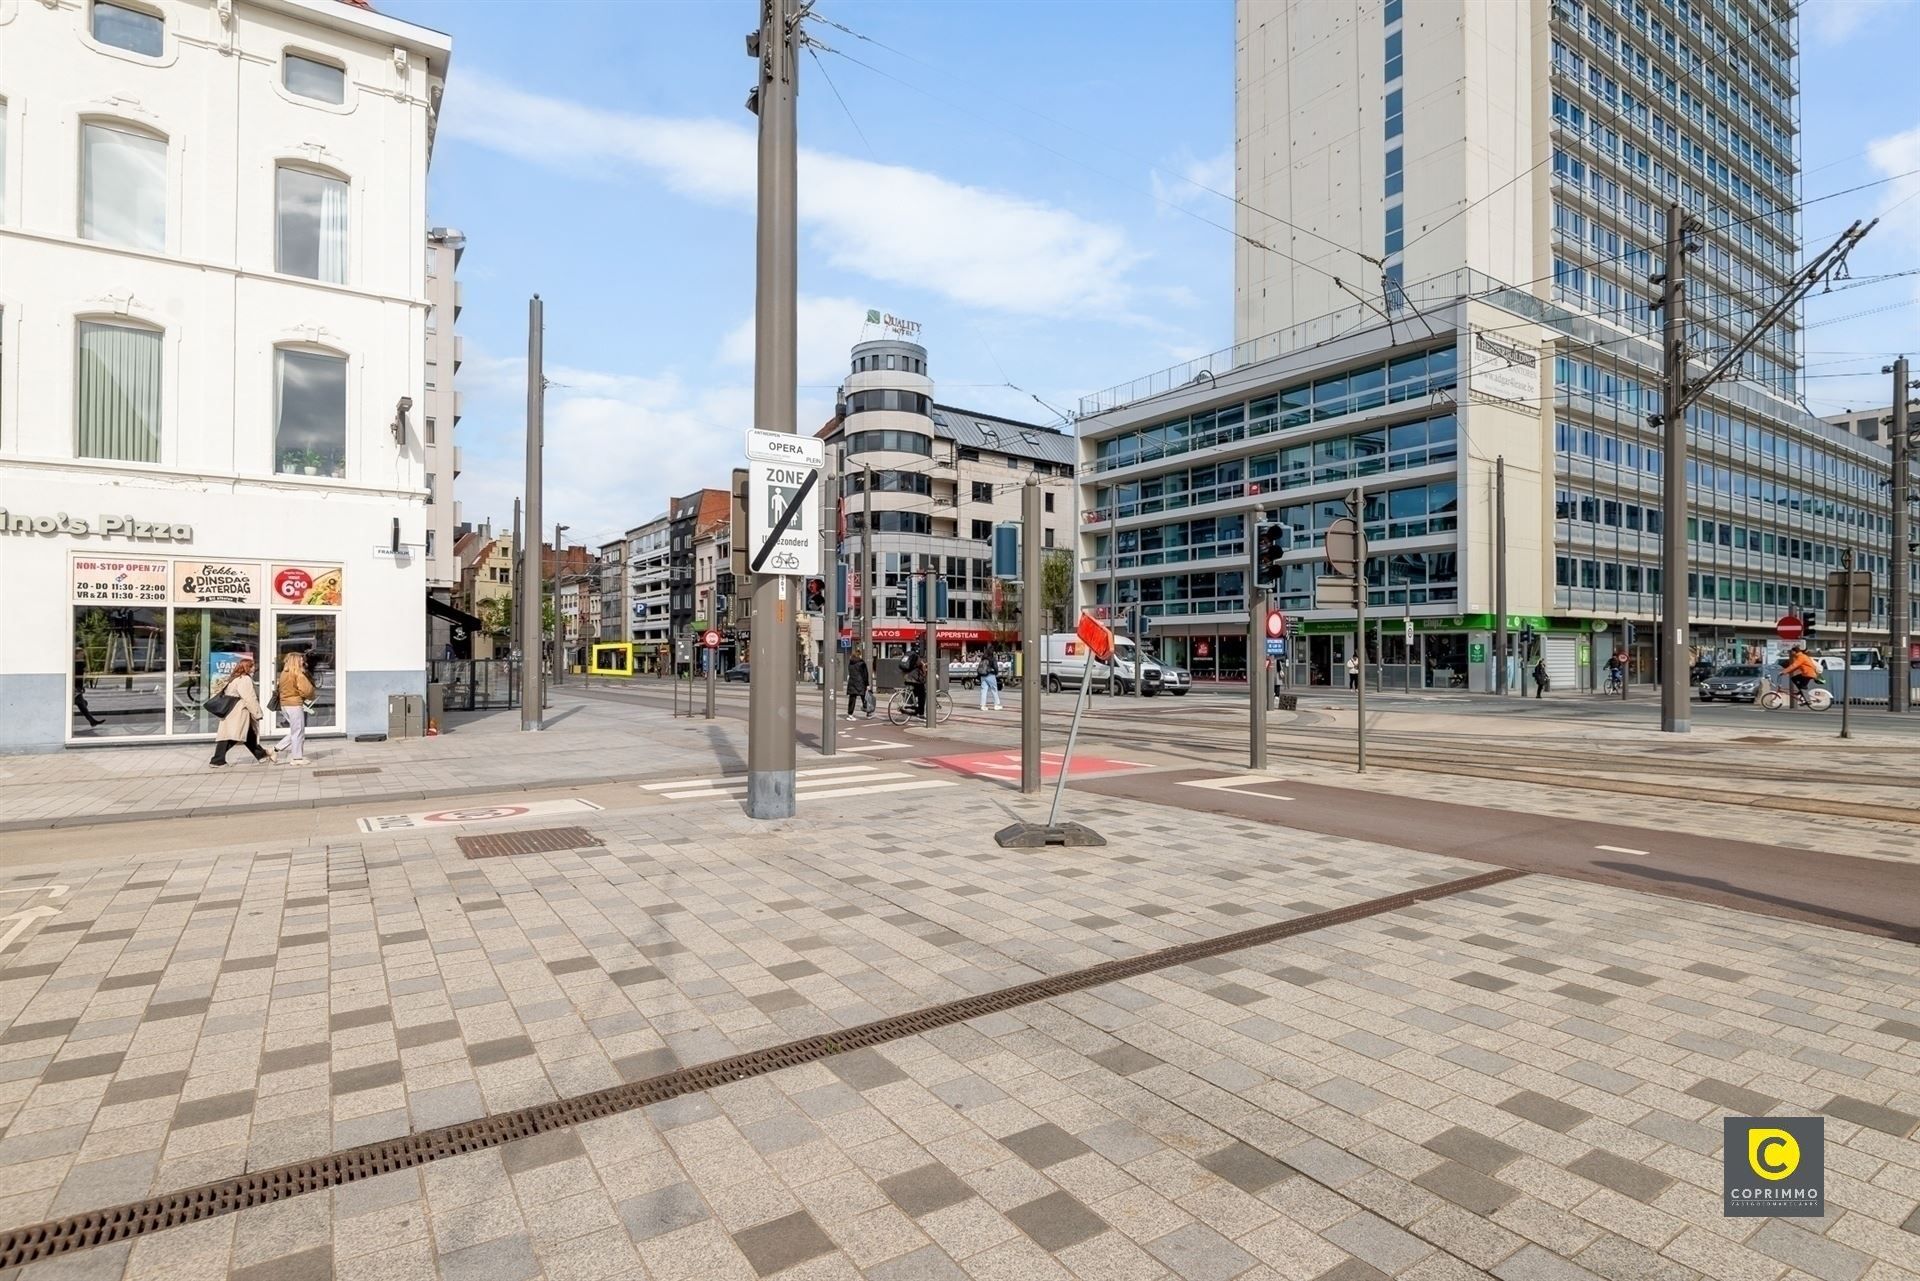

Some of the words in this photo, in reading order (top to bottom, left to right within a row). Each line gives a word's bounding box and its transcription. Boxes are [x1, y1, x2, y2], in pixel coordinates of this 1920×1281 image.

[884, 313, 922, 332] QUALITY
[892, 328, 914, 336] HOTEL
[769, 442, 803, 454] OPERA
[766, 468, 804, 485] ZONE
[100, 514, 191, 540] Pizza
[762, 535, 808, 547] Uezonderd
[76, 562, 124, 571] NON-STOP
[183, 576, 197, 593] &
[196, 576, 250, 586] DINSDAG
[198, 583, 251, 593] ZATERDAG
[637, 603, 644, 613] P
[936, 631, 979, 639] APPERSTEAM
